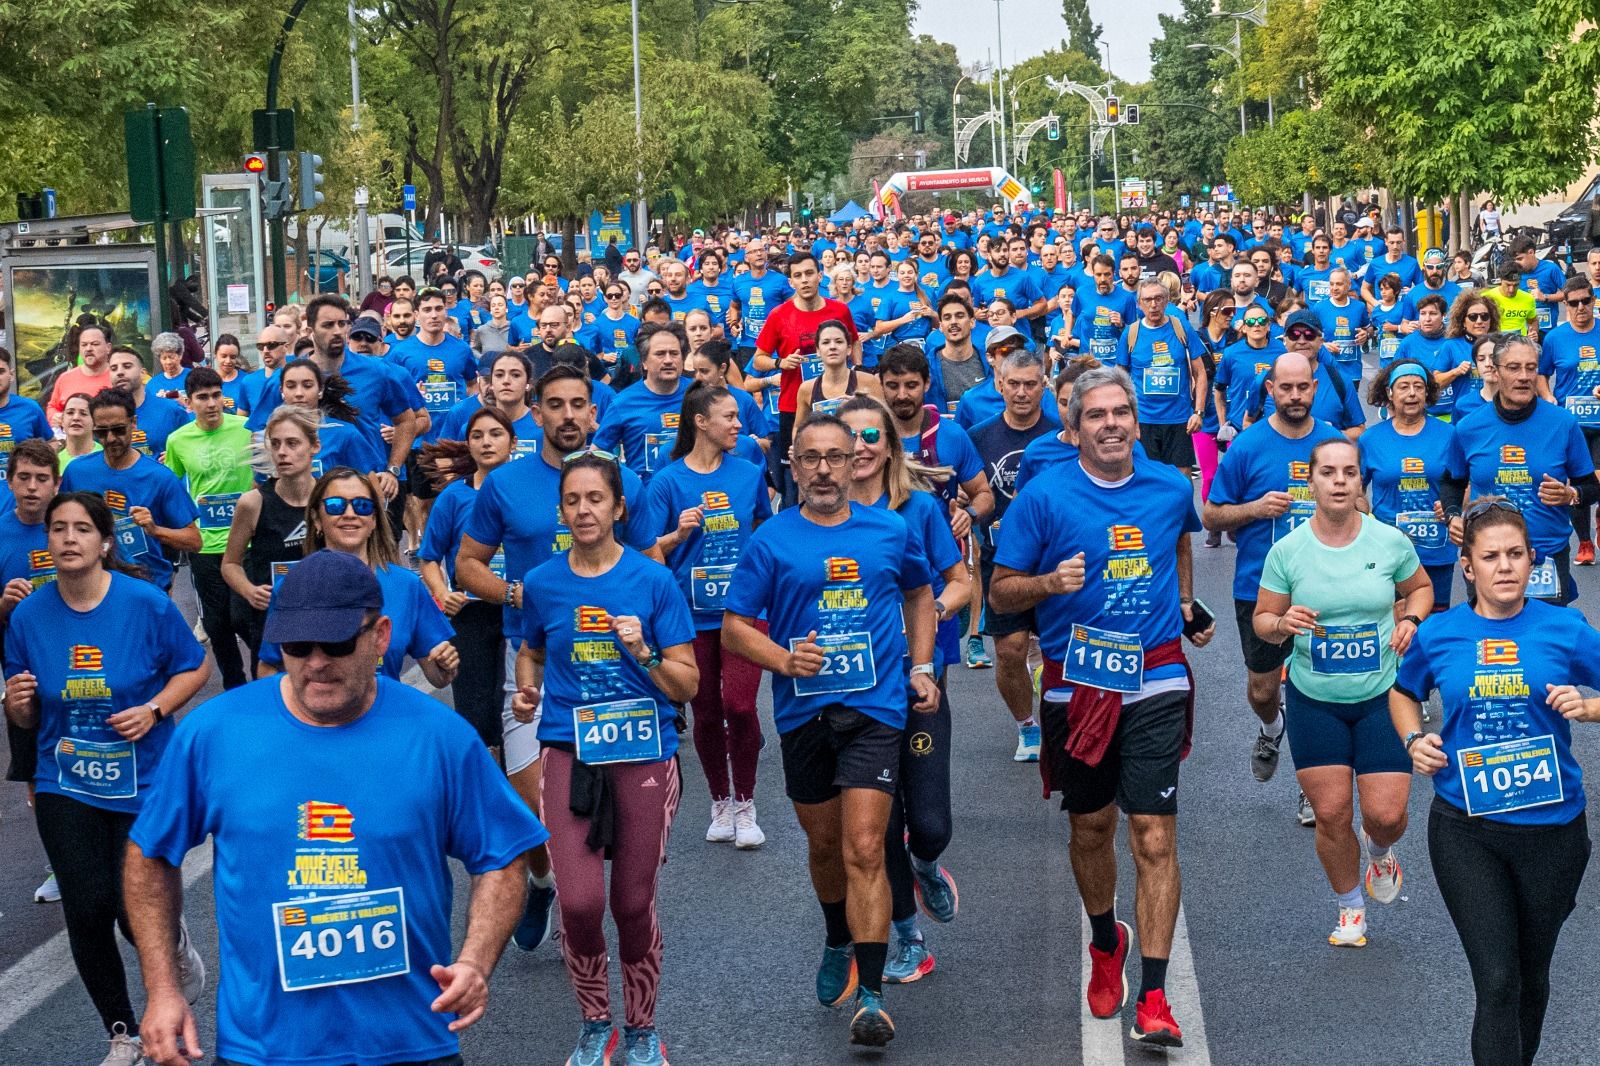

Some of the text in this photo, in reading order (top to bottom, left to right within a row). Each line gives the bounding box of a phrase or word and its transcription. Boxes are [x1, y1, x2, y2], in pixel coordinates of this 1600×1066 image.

[1092, 345, 1116, 354] 1093
[1151, 376, 1173, 386] 361
[424, 392, 449, 403] 934
[1569, 405, 1600, 415] 1057
[207, 505, 235, 518] 143
[1407, 524, 1438, 537] 283
[1108, 556, 1148, 570] MUÉVETE
[1102, 566, 1153, 580] X VALENCIA
[823, 588, 863, 600] MUÉVETE
[818, 598, 868, 609] X VALENCIA
[573, 640, 615, 652] MUÉVETE
[1316, 640, 1376, 659] 1205
[579, 651, 621, 662] VALENCIA
[1074, 646, 1139, 674] 1163
[818, 653, 864, 675] 231
[67, 678, 106, 689] MUÉVETE
[1474, 672, 1524, 686] MUÉVETE
[70, 688, 112, 698] VALENCIA
[1469, 685, 1530, 697] X VALENCIA
[584, 719, 653, 744] 4015
[1486, 754, 1515, 765] MUÉVETE
[1522, 747, 1551, 759] VALENCIA
[71, 760, 121, 781] 465
[1473, 759, 1553, 793] 1054
[295, 852, 359, 870] MUÉVETE
[288, 870, 367, 885] X VALENCIA
[311, 911, 349, 924] MUÉVETE
[359, 905, 398, 918] VALENCIA
[291, 920, 396, 960] 4016
